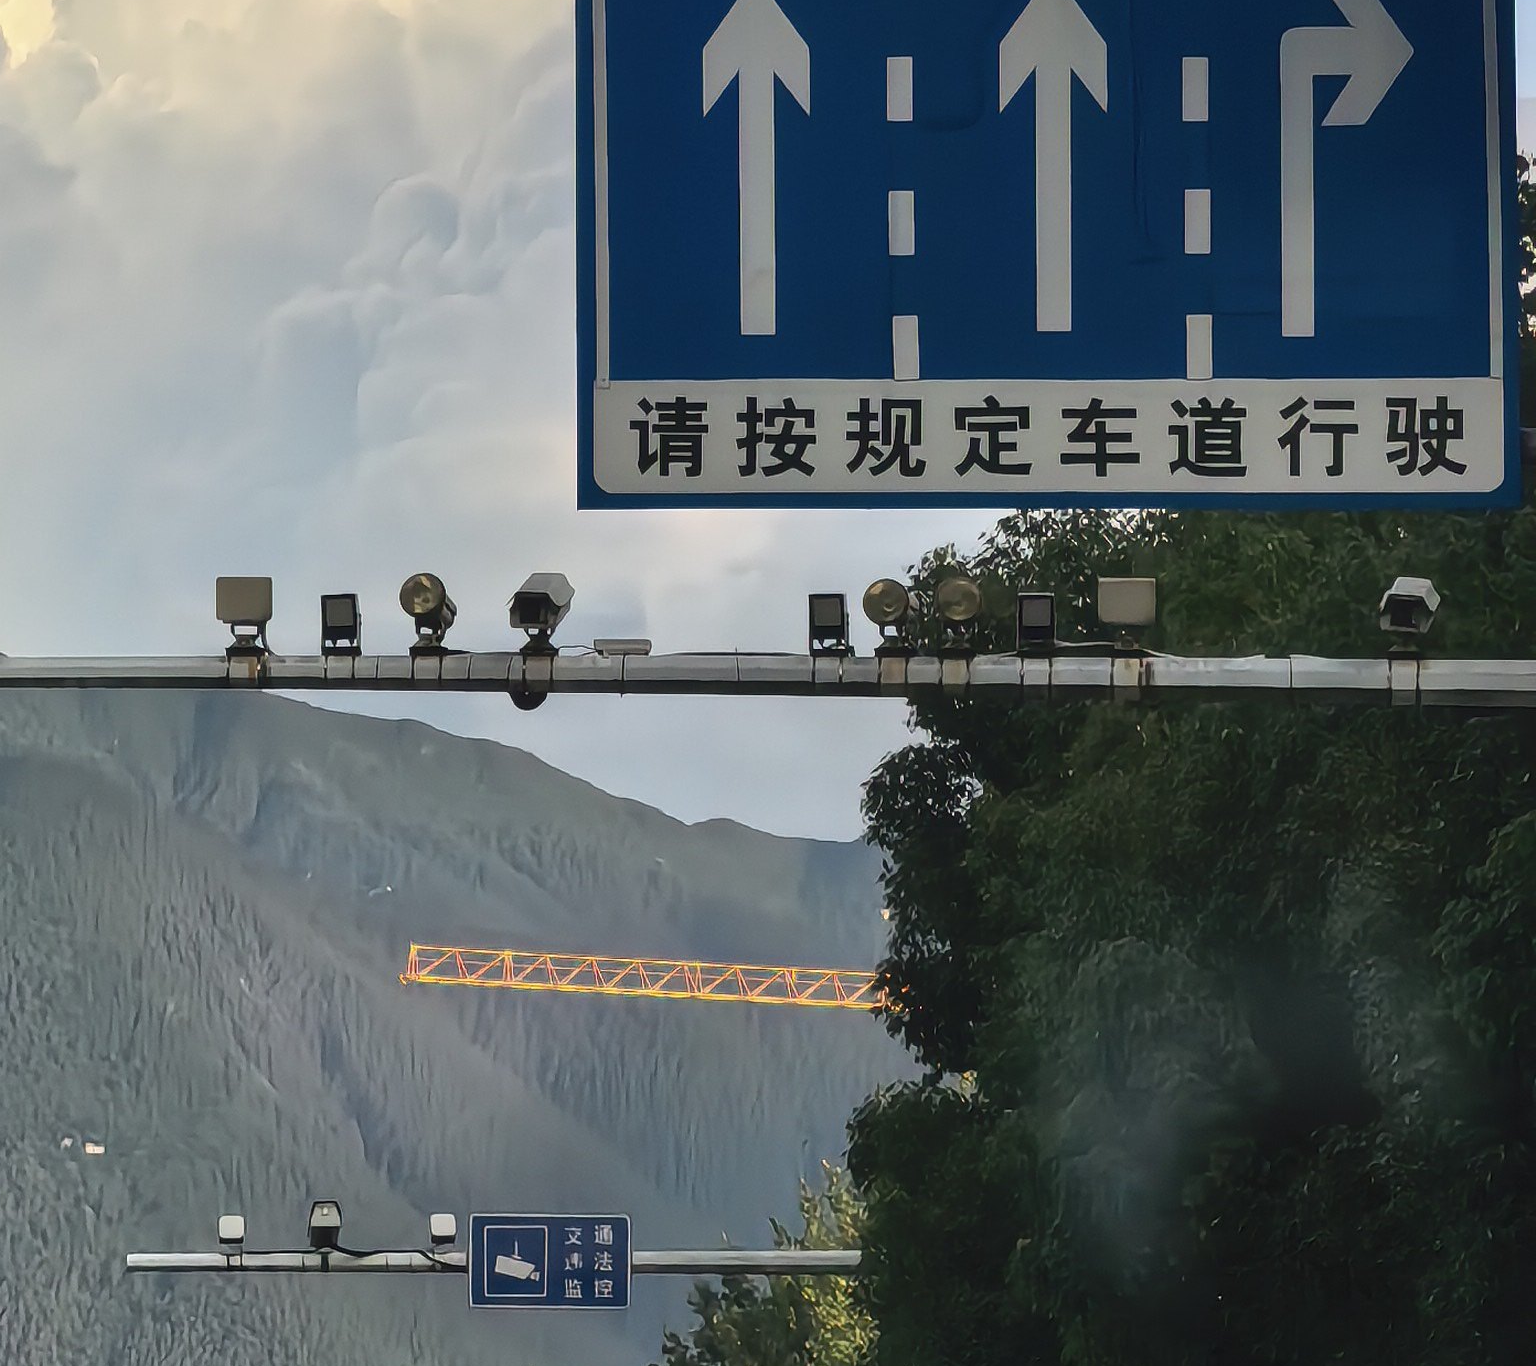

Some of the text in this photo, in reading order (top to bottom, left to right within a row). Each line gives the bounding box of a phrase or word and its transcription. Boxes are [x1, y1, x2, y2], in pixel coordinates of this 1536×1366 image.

[629, 394, 1468, 478] 请按规定车道行驶
[564, 1224, 613, 1245] 交通
